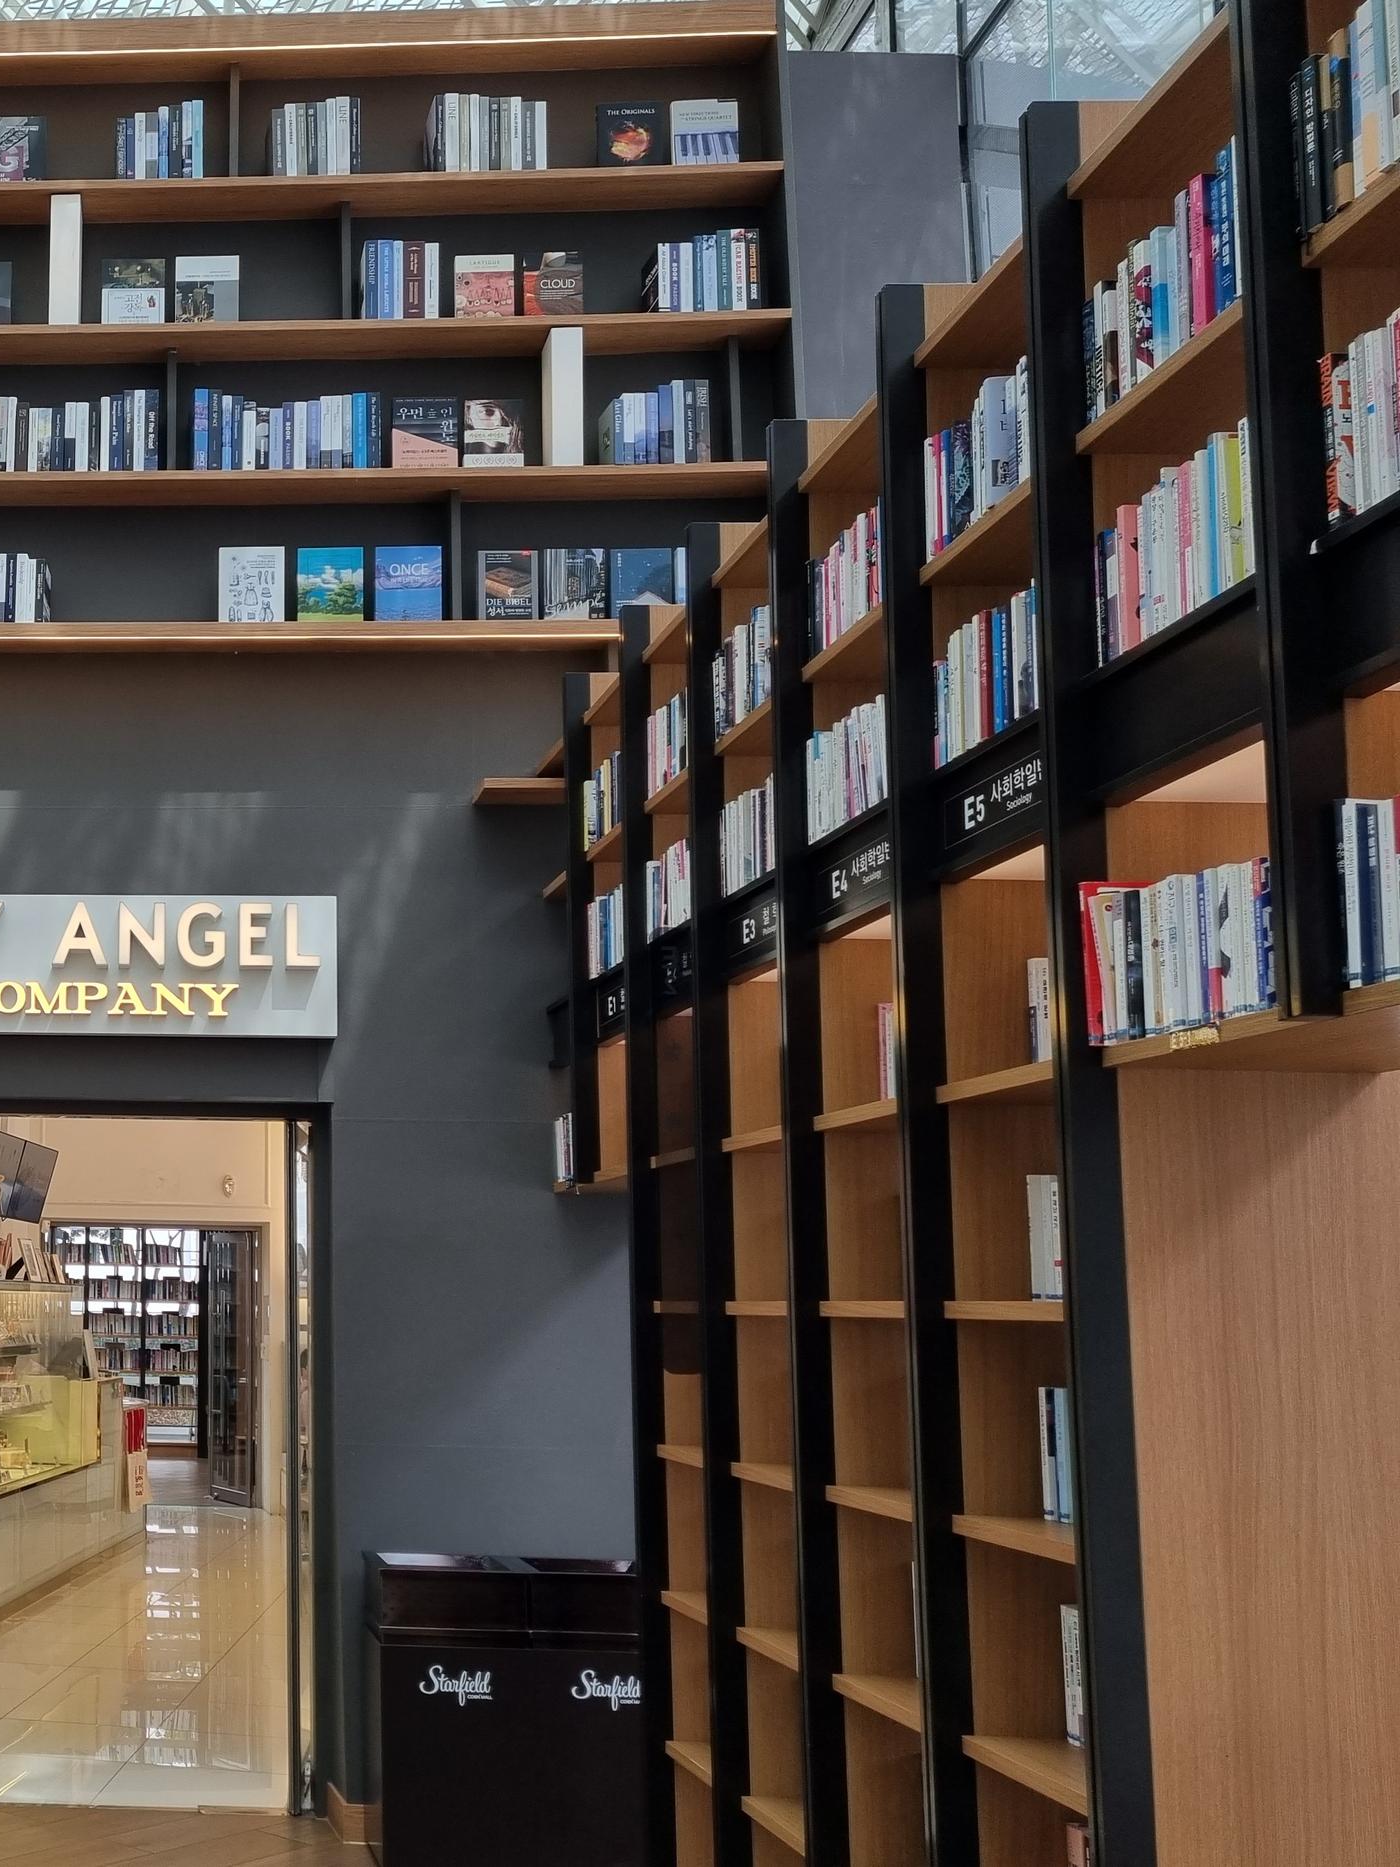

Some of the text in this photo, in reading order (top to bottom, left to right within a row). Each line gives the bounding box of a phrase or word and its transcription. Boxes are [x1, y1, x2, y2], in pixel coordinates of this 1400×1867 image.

[621, 107, 656, 115] ORIGINALS
[540, 279, 575, 289] CLOUD
[700, 387, 708, 407] IRISH
[397, 407, 452, 420] 우먼 인
[389, 563, 429, 577] ONCE
[486, 598, 531, 606] DIE BIBEL
[1006, 792, 1033, 811] Sociology
[964, 794, 985, 830] E5
[831, 869, 848, 899] E4
[862, 869, 882, 885] Sociology
[51, 900, 321, 970] ANGEL
[743, 918, 756, 944] E3
[419, 1664, 492, 1707] Starfield
[571, 1669, 641, 1712] Starfield
